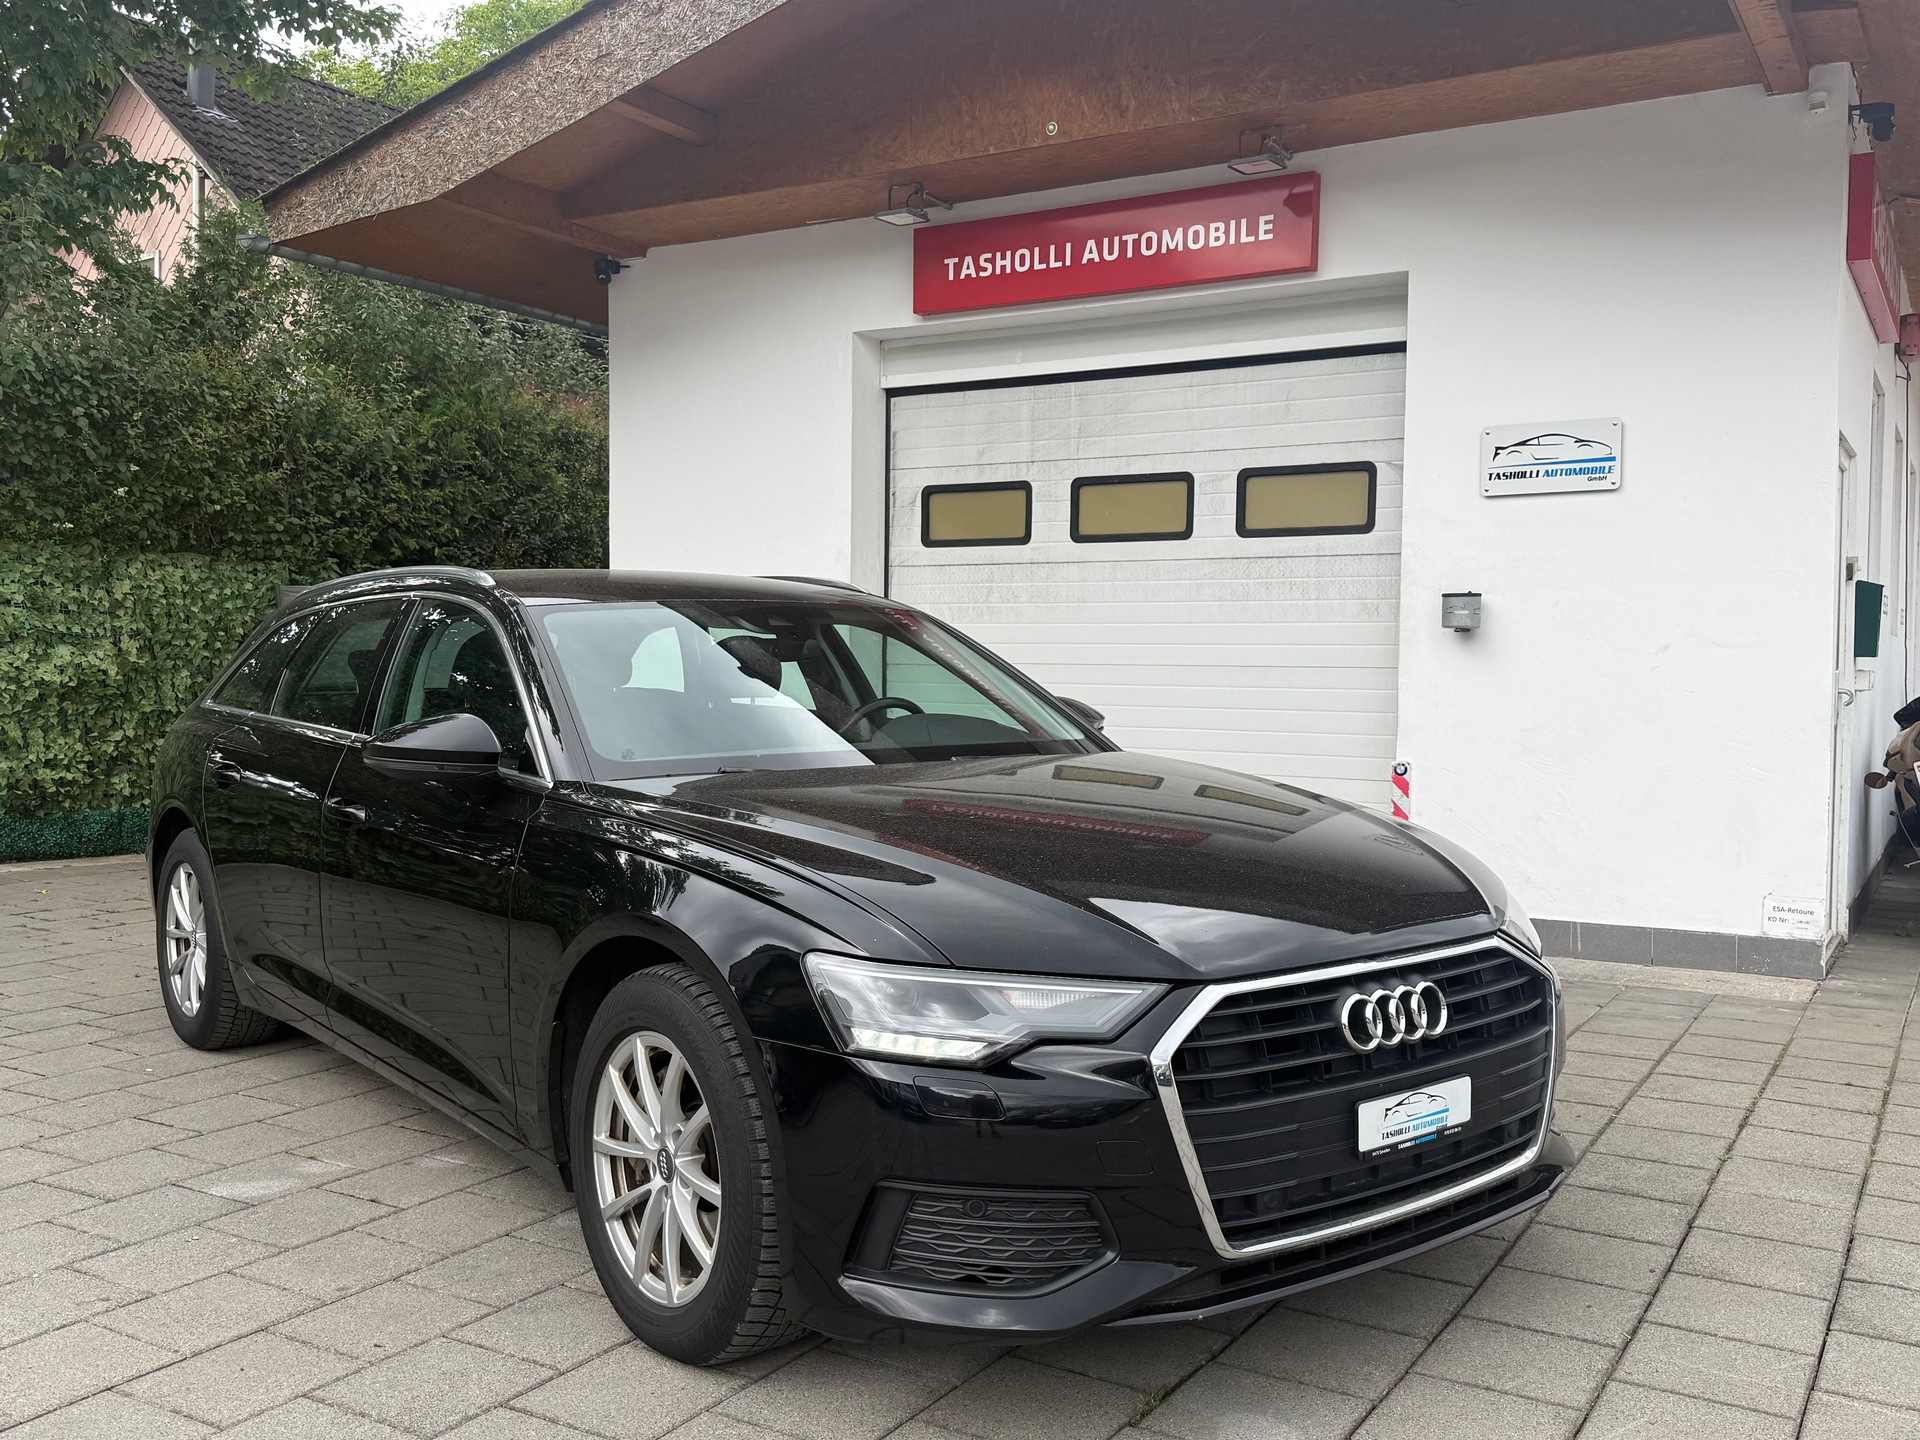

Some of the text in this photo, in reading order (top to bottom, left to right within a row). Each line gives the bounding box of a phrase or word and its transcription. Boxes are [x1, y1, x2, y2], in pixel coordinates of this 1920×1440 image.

[944, 214, 1275, 281] TASHOLLI AUTOMOBILE
[1487, 465, 1615, 482] TASHOLLI AUTOMOBILE
[1772, 905, 1815, 916] ESA-Retoure
[1381, 1125, 1411, 1141] TASHOLLI
[1411, 1115, 1449, 1132] AUTOMOBILE
